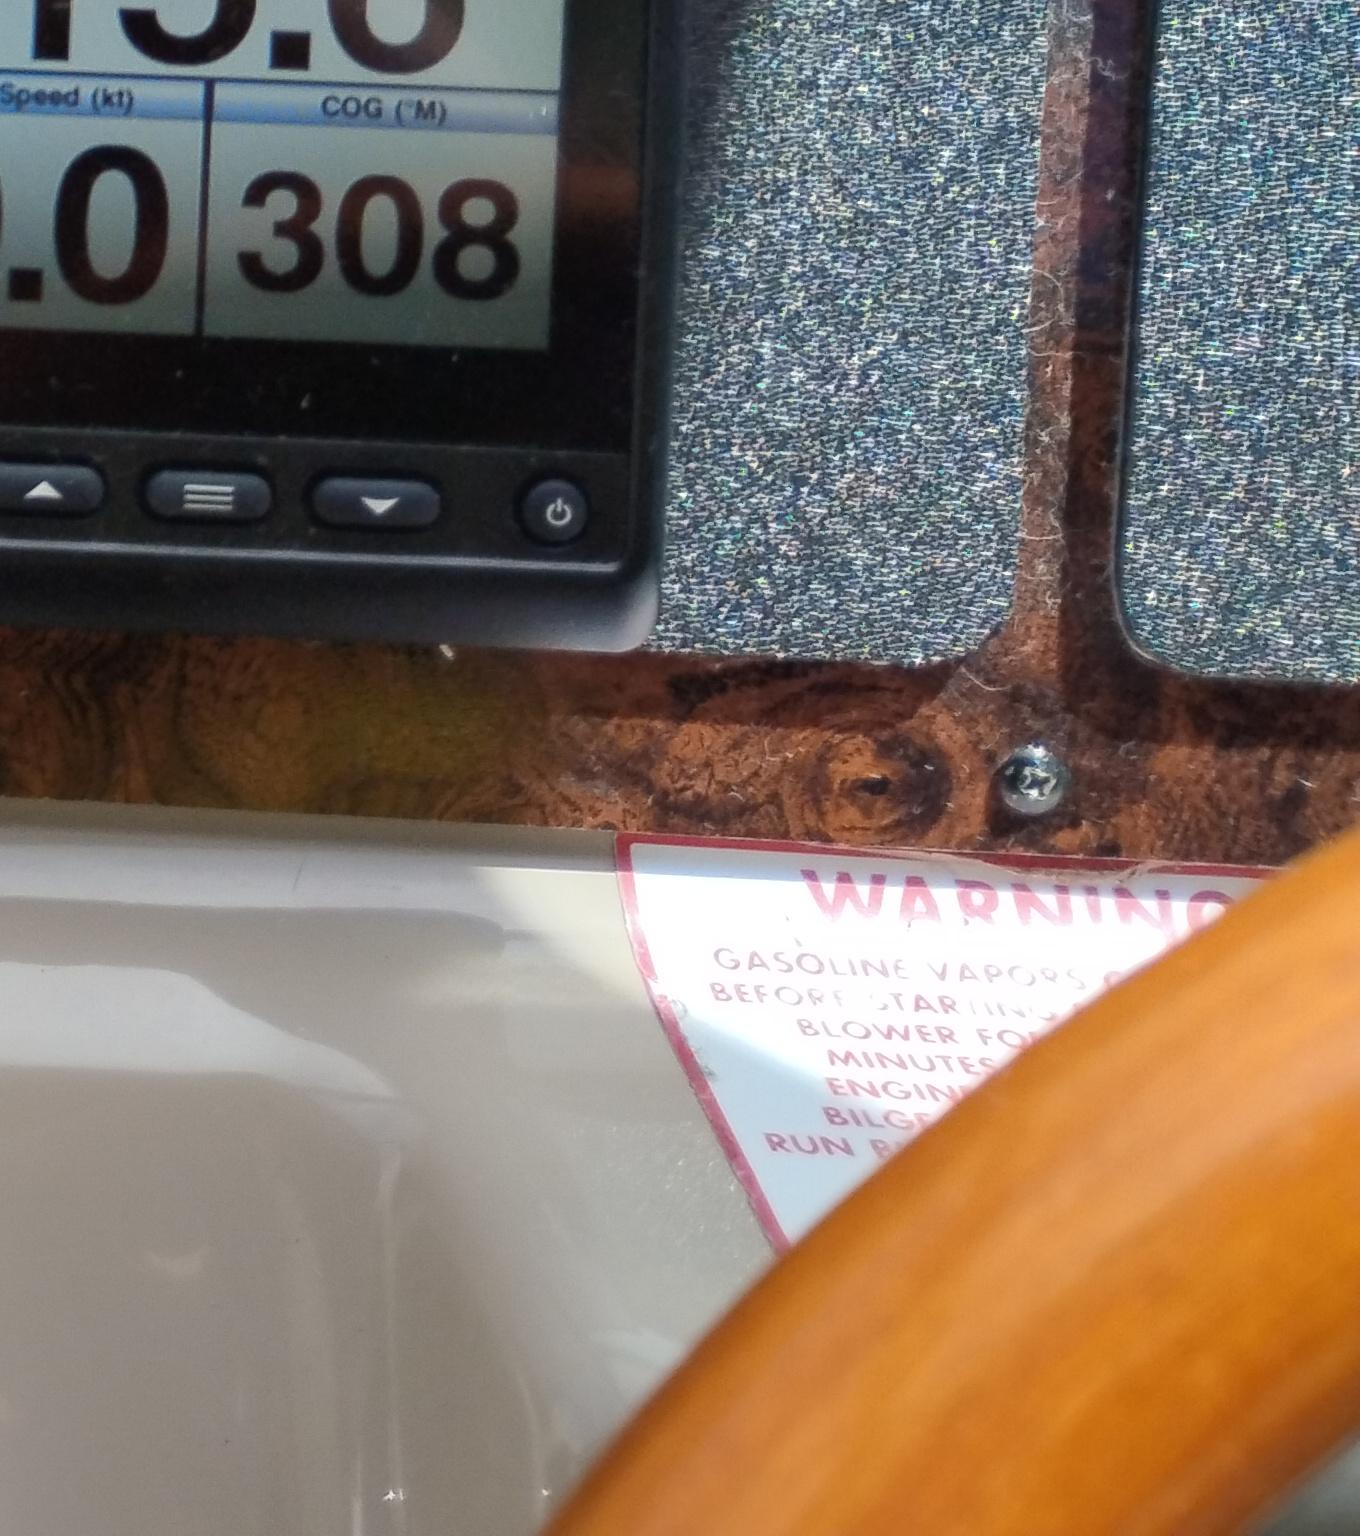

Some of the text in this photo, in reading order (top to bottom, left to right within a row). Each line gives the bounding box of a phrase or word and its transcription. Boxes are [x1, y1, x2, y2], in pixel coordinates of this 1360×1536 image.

[0, 82, 80, 112] Speed
[91, 87, 134, 115] (kt)
[321, 95, 383, 120] COG
[237, 171, 520, 300] 308
[713, 948, 908, 978] GASOLINE
[929, 962, 1086, 990] VAPORS
[797, 1019, 1041, 1049] BLOWER FO
[764, 1133, 855, 1156] RUN
